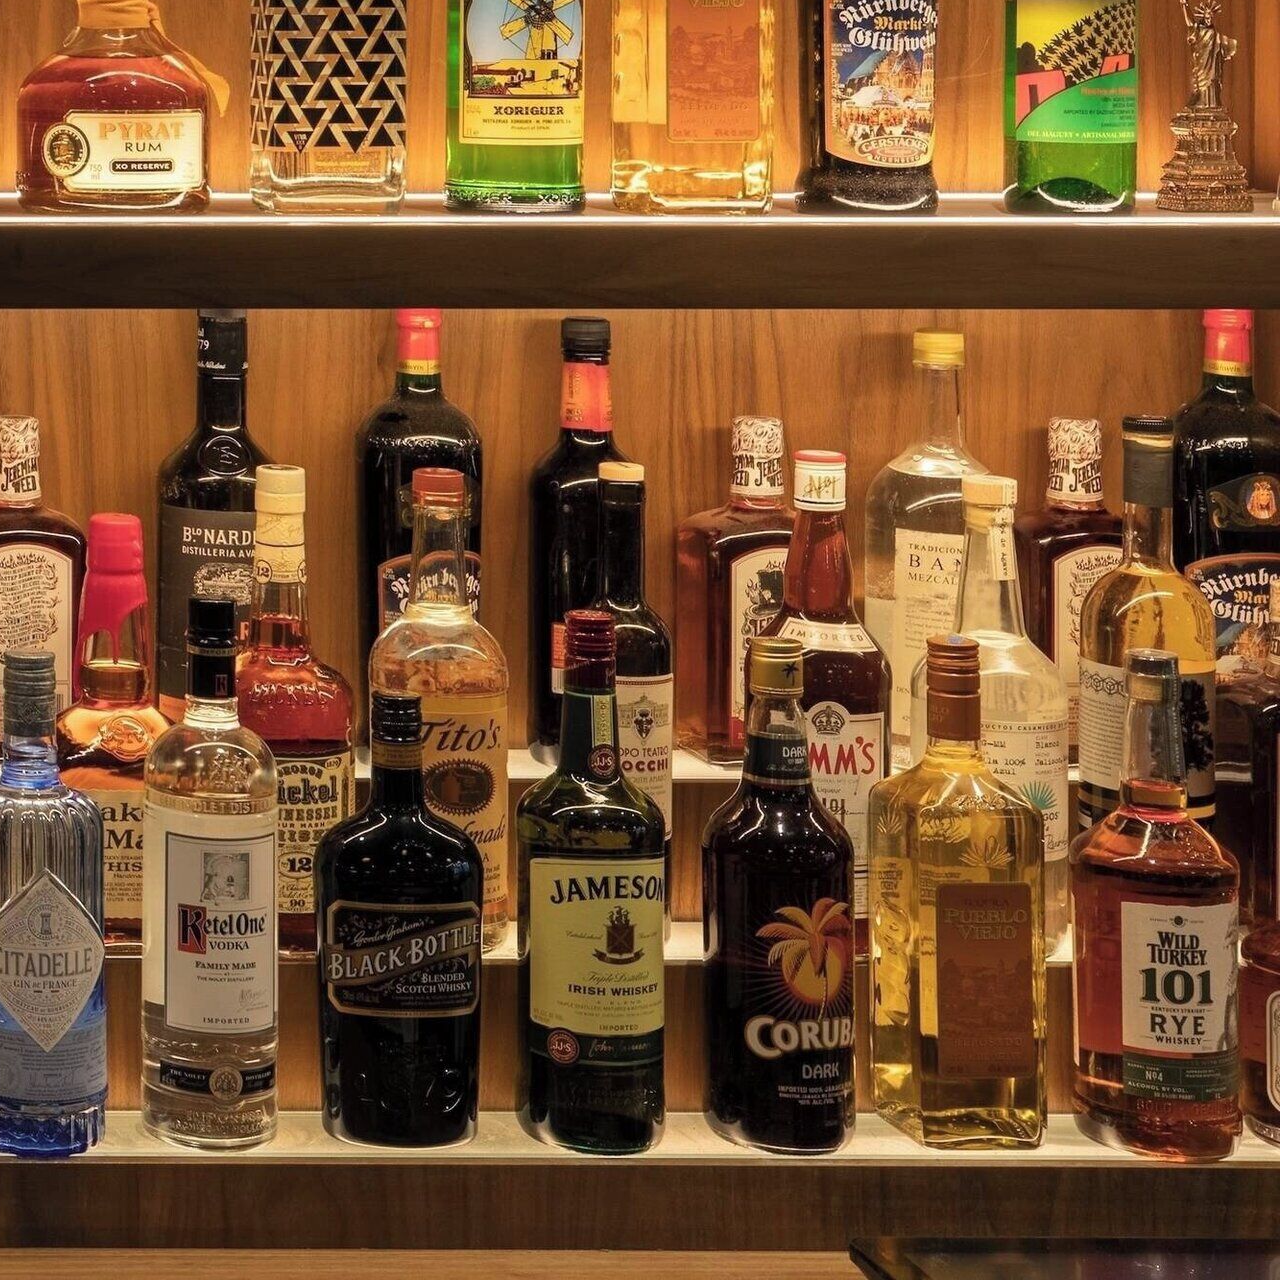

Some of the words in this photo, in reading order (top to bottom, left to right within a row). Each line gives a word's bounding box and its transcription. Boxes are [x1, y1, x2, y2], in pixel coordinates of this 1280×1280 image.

[493, 106, 564, 116] XORIGUER
[98, 120, 184, 141] PYRAT
[125, 142, 162, 152] RUM
[115, 162, 128, 171] XO
[131, 162, 171, 171] RESERVE
[13, 475, 37, 493] WEED
[182, 546, 236, 557] DISTILLERIA
[908, 572, 957, 585] MEZCAL
[789, 628, 864, 643] IMPORTED
[642, 747, 668, 757] TEATRO
[1004, 758, 1025, 767] 100%
[289, 857, 312, 872] 12
[550, 874, 665, 904] JAMESON
[290, 899, 305, 907] 90
[944, 909, 1028, 922] PUEBLO
[178, 904, 234, 953] Ketel
[236, 912, 265, 935] One
[957, 925, 1017, 941] VIEJO
[209, 941, 249, 951] VODKA
[1157, 931, 1200, 950] WILD
[328, 948, 403, 981] BLACK
[406, 923, 480, 962] BOTTLE
[1147, 943, 1207, 967] TURKEY
[195, 961, 230, 970] FAMILY
[232, 961, 256, 969] MADE
[13, 979, 30, 989] GIN
[43, 979, 77, 990] FRANCE
[421, 973, 465, 984] BLENDED
[395, 983, 437, 994] SCOTCH
[438, 982, 472, 992] WHISKY
[568, 984, 607, 996] IRISH
[611, 983, 658, 996] WHISKEY
[1140, 968, 1213, 1005] 101
[598, 1023, 639, 1032] IMPORTED
[1150, 1013, 1205, 1035] RYE
[1155, 1036, 1202, 1045] WHISKEY
[801, 1062, 840, 1080] DARK
[1128, 1081, 1160, 1091] ALCOHOL
